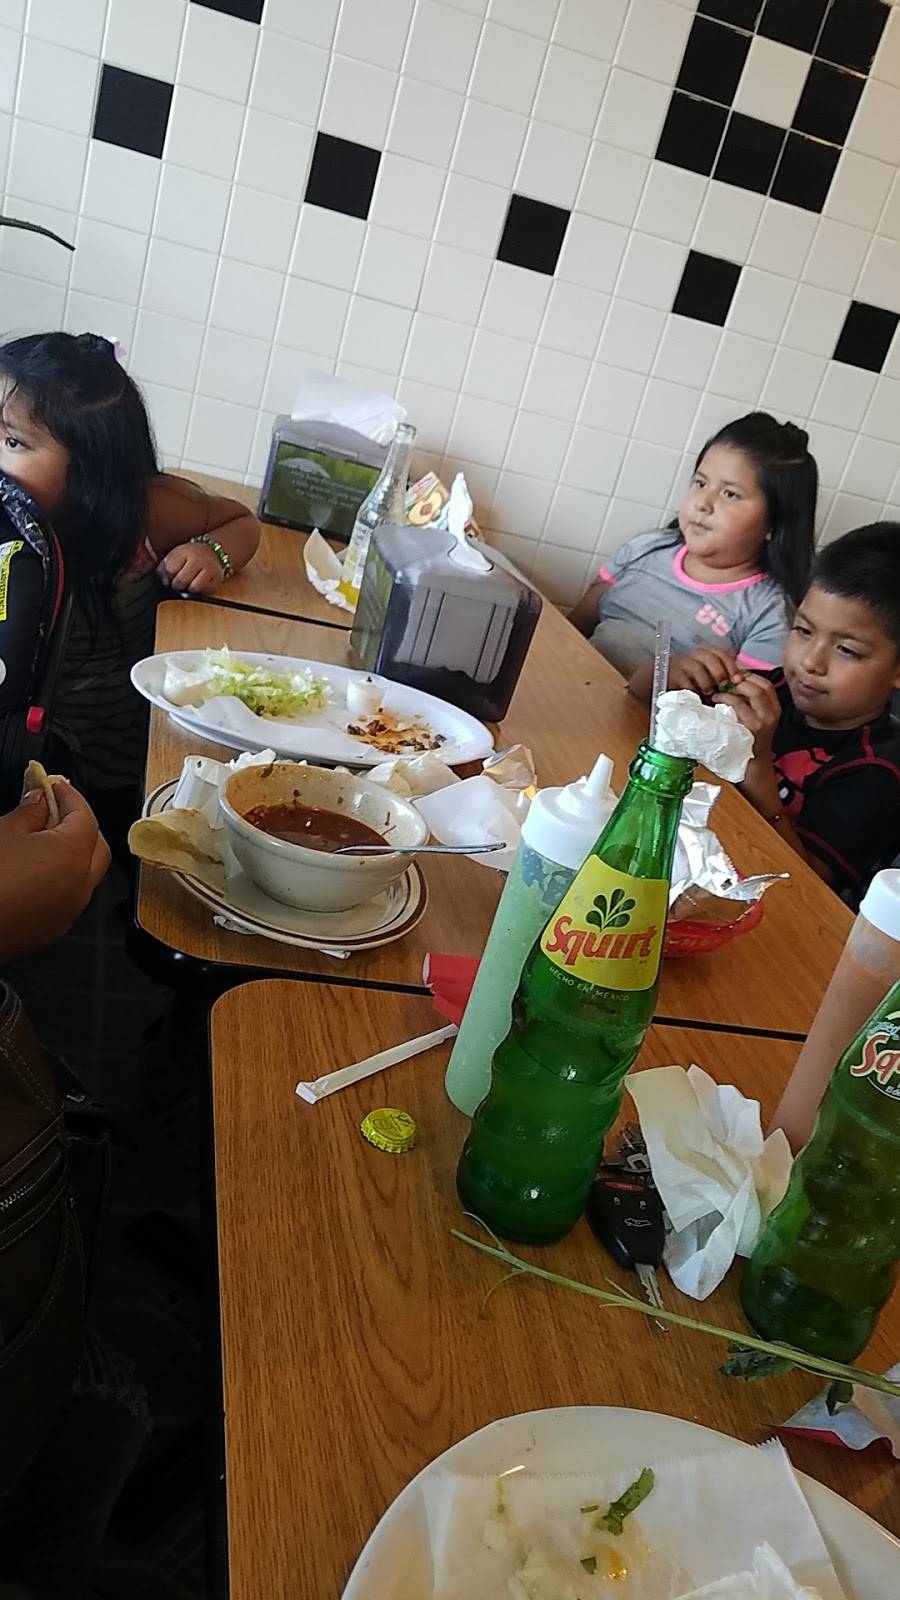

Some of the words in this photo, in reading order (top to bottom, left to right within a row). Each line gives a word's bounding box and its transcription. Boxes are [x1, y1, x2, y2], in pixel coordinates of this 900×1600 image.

[546, 915, 657, 966] Squirt
[549, 966, 575, 986] HECHO
[577, 983, 590, 993] EN
[850, 1031, 900, 1086] Sq
